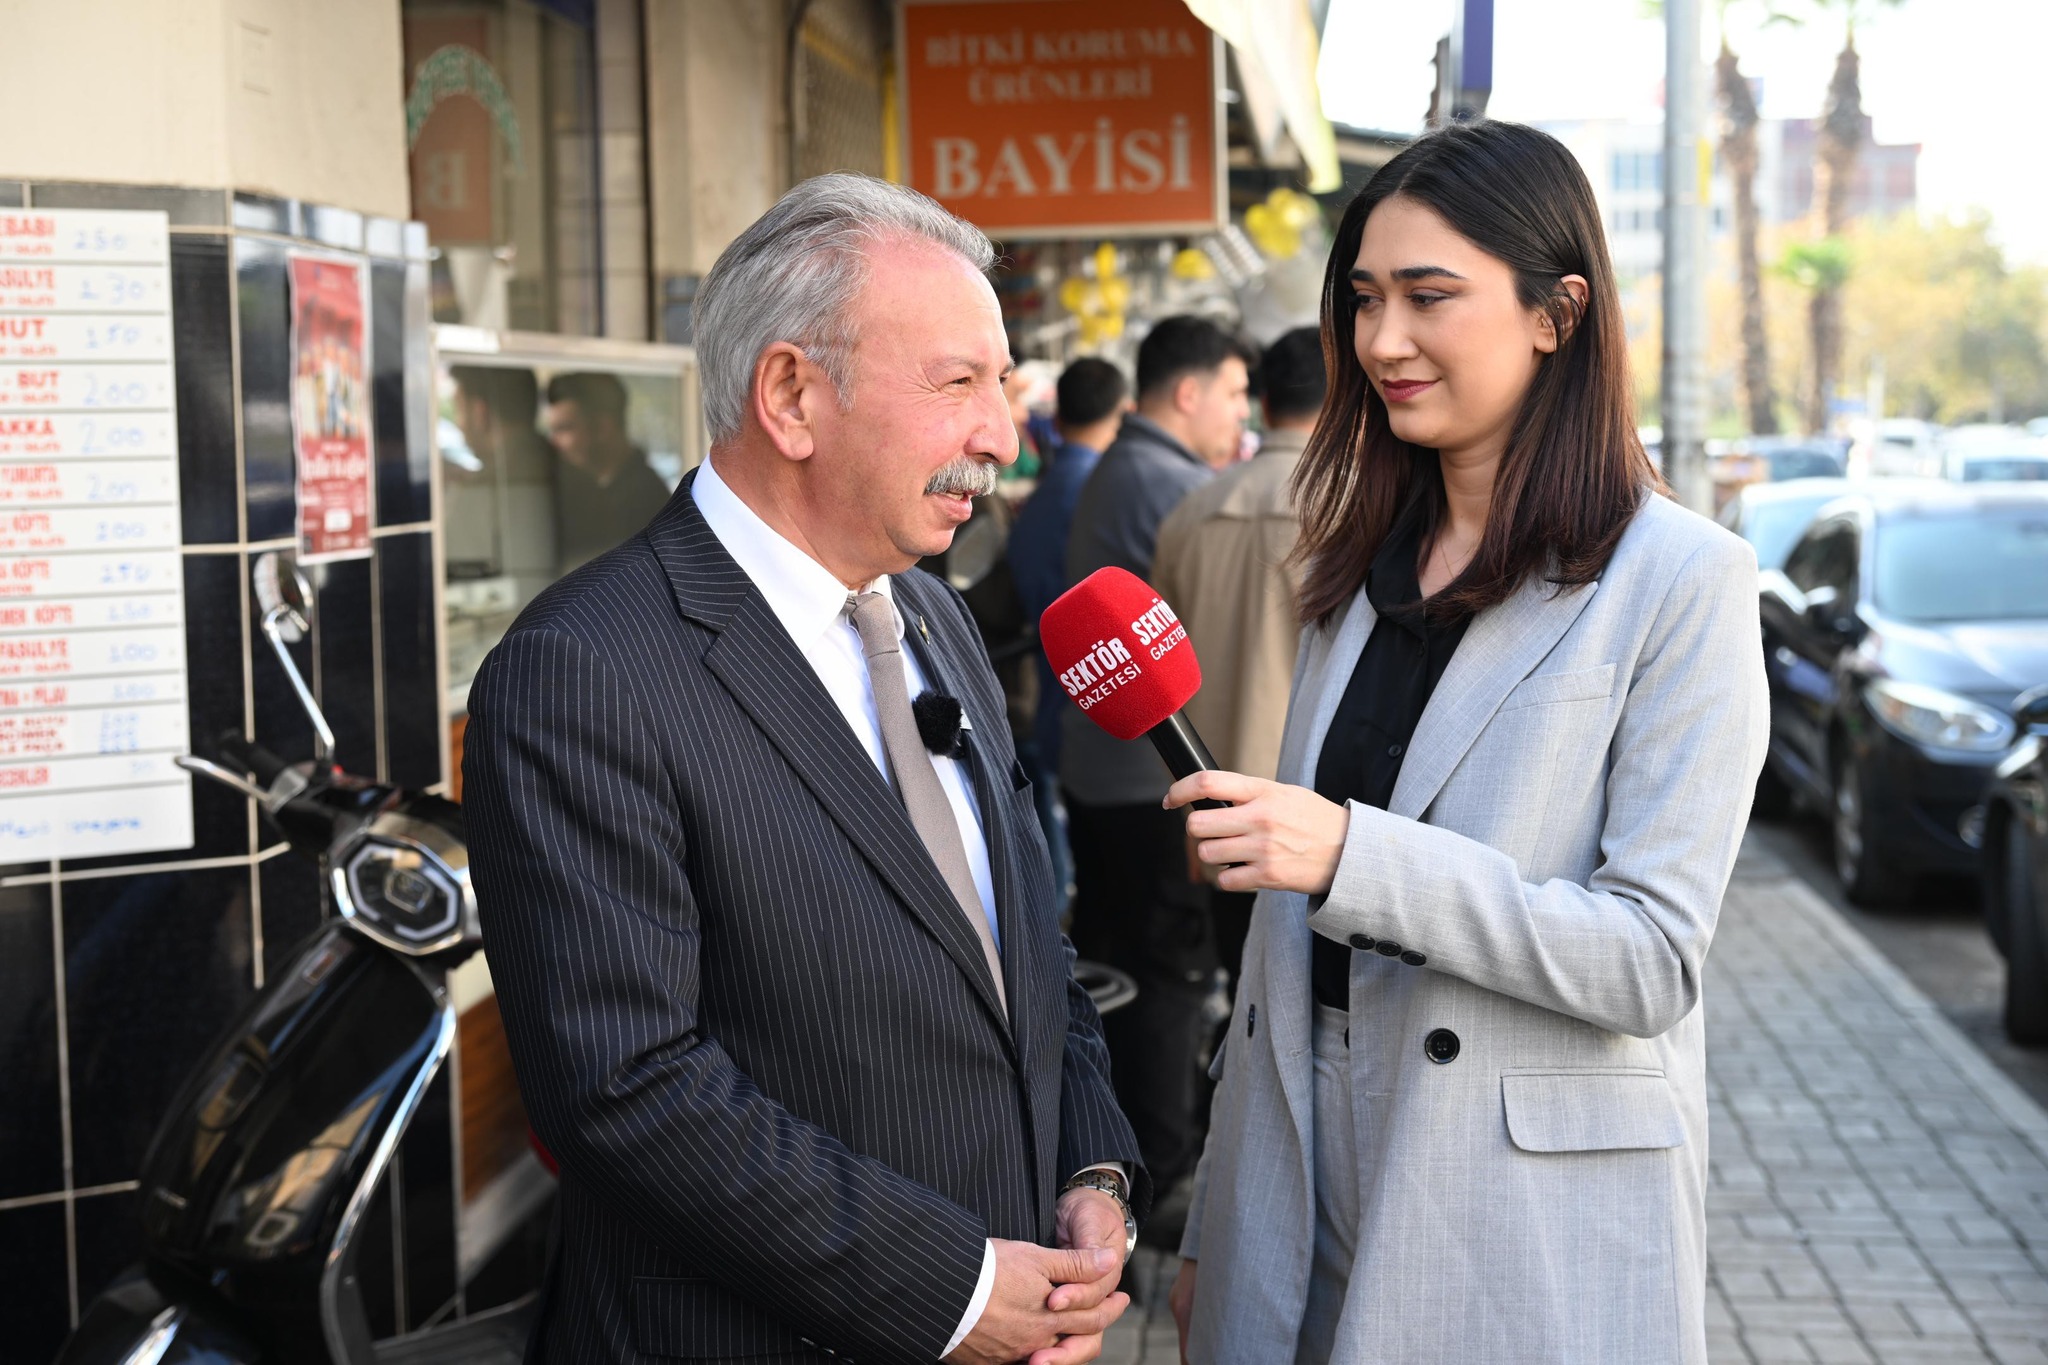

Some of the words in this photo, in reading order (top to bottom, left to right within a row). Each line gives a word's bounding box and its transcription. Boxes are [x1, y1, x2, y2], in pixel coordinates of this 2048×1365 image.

[925, 28, 1023, 67] BİTKİ
[1032, 28, 1194, 62] KORUMA
[968, 65, 1152, 105] ÜRÜNLERİ
[932, 114, 1193, 198] BAYİSİ
[1060, 637, 1132, 697] SEKTÖR
[1078, 660, 1142, 711] GAZETESİ
